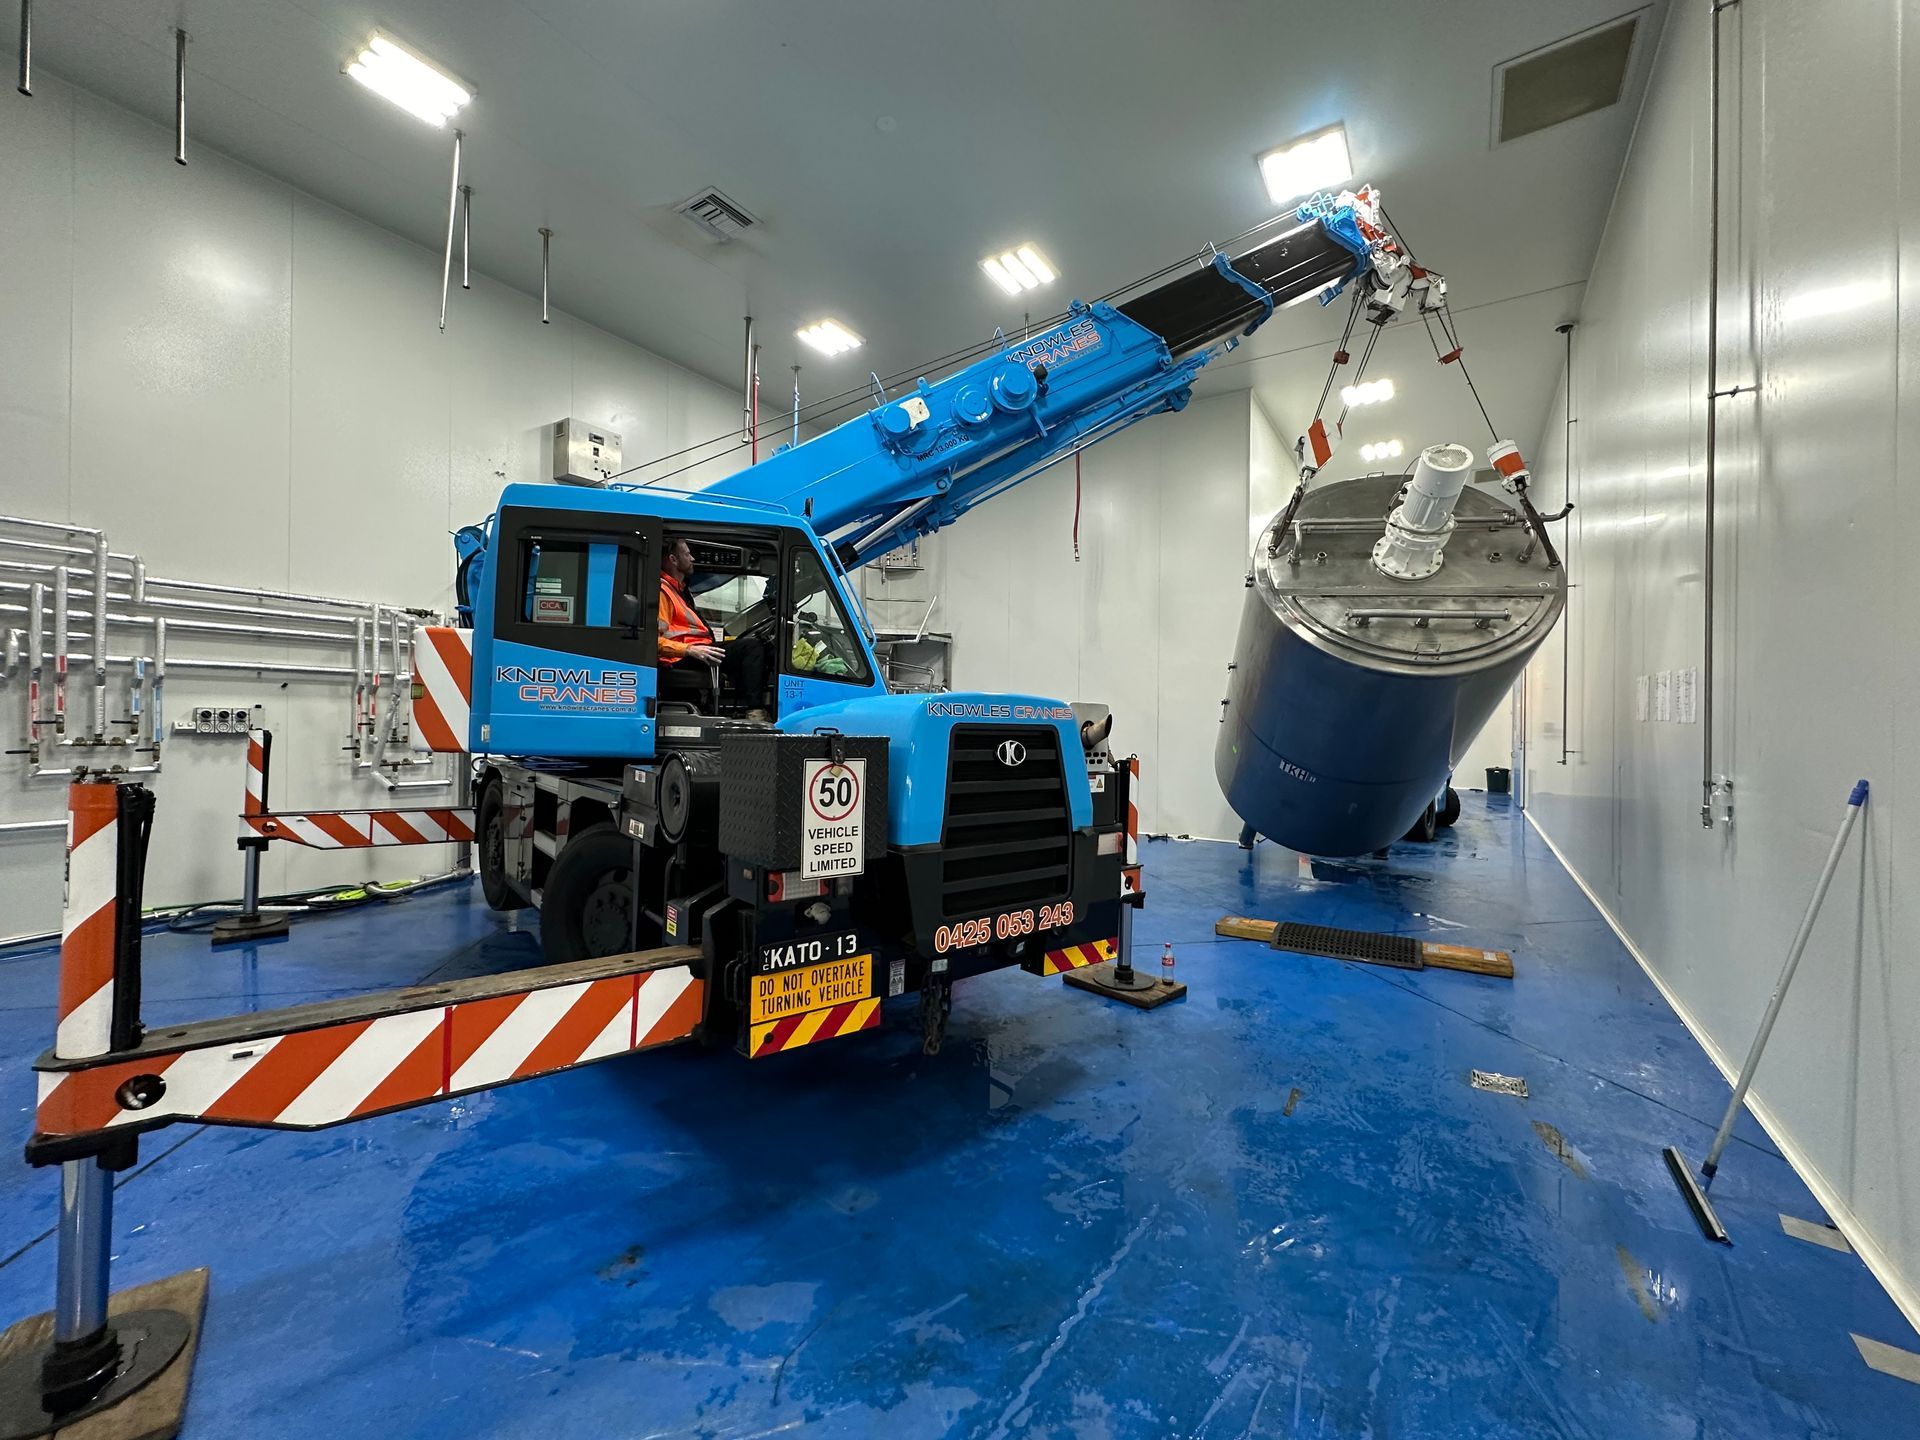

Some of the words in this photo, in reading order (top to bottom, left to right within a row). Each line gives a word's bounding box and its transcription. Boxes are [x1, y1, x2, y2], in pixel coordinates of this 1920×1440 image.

[1006, 319, 1095, 363] KNOWLES
[1027, 331, 1100, 372] CRANES
[540, 601, 560, 609] CICA
[496, 666, 637, 686] KNOWLES
[784, 680, 804, 688] UNIT
[519, 685, 637, 704] CRANES
[785, 690, 803, 699] 13-1
[540, 704, 636, 713] www.knowlescranes.com.au
[927, 702, 1010, 717] KNOWLES
[1013, 706, 1073, 719] CRANES
[819, 777, 852, 807] 50
[808, 826, 858, 839] VEHICLE
[814, 842, 853, 855] SPEED
[810, 857, 856, 872] LIMITED
[935, 917, 991, 953] 0425
[996, 909, 1034, 939] 053
[1039, 901, 1074, 930] 243
[770, 941, 821, 969] KATO
[837, 934, 857, 956] 13
[760, 978, 774, 997] DO
[783, 973, 804, 992] NOT
[811, 961, 864, 985] OVERTAKE
[761, 990, 811, 1016] TURNING
[819, 979, 863, 1002] VEHICLE
